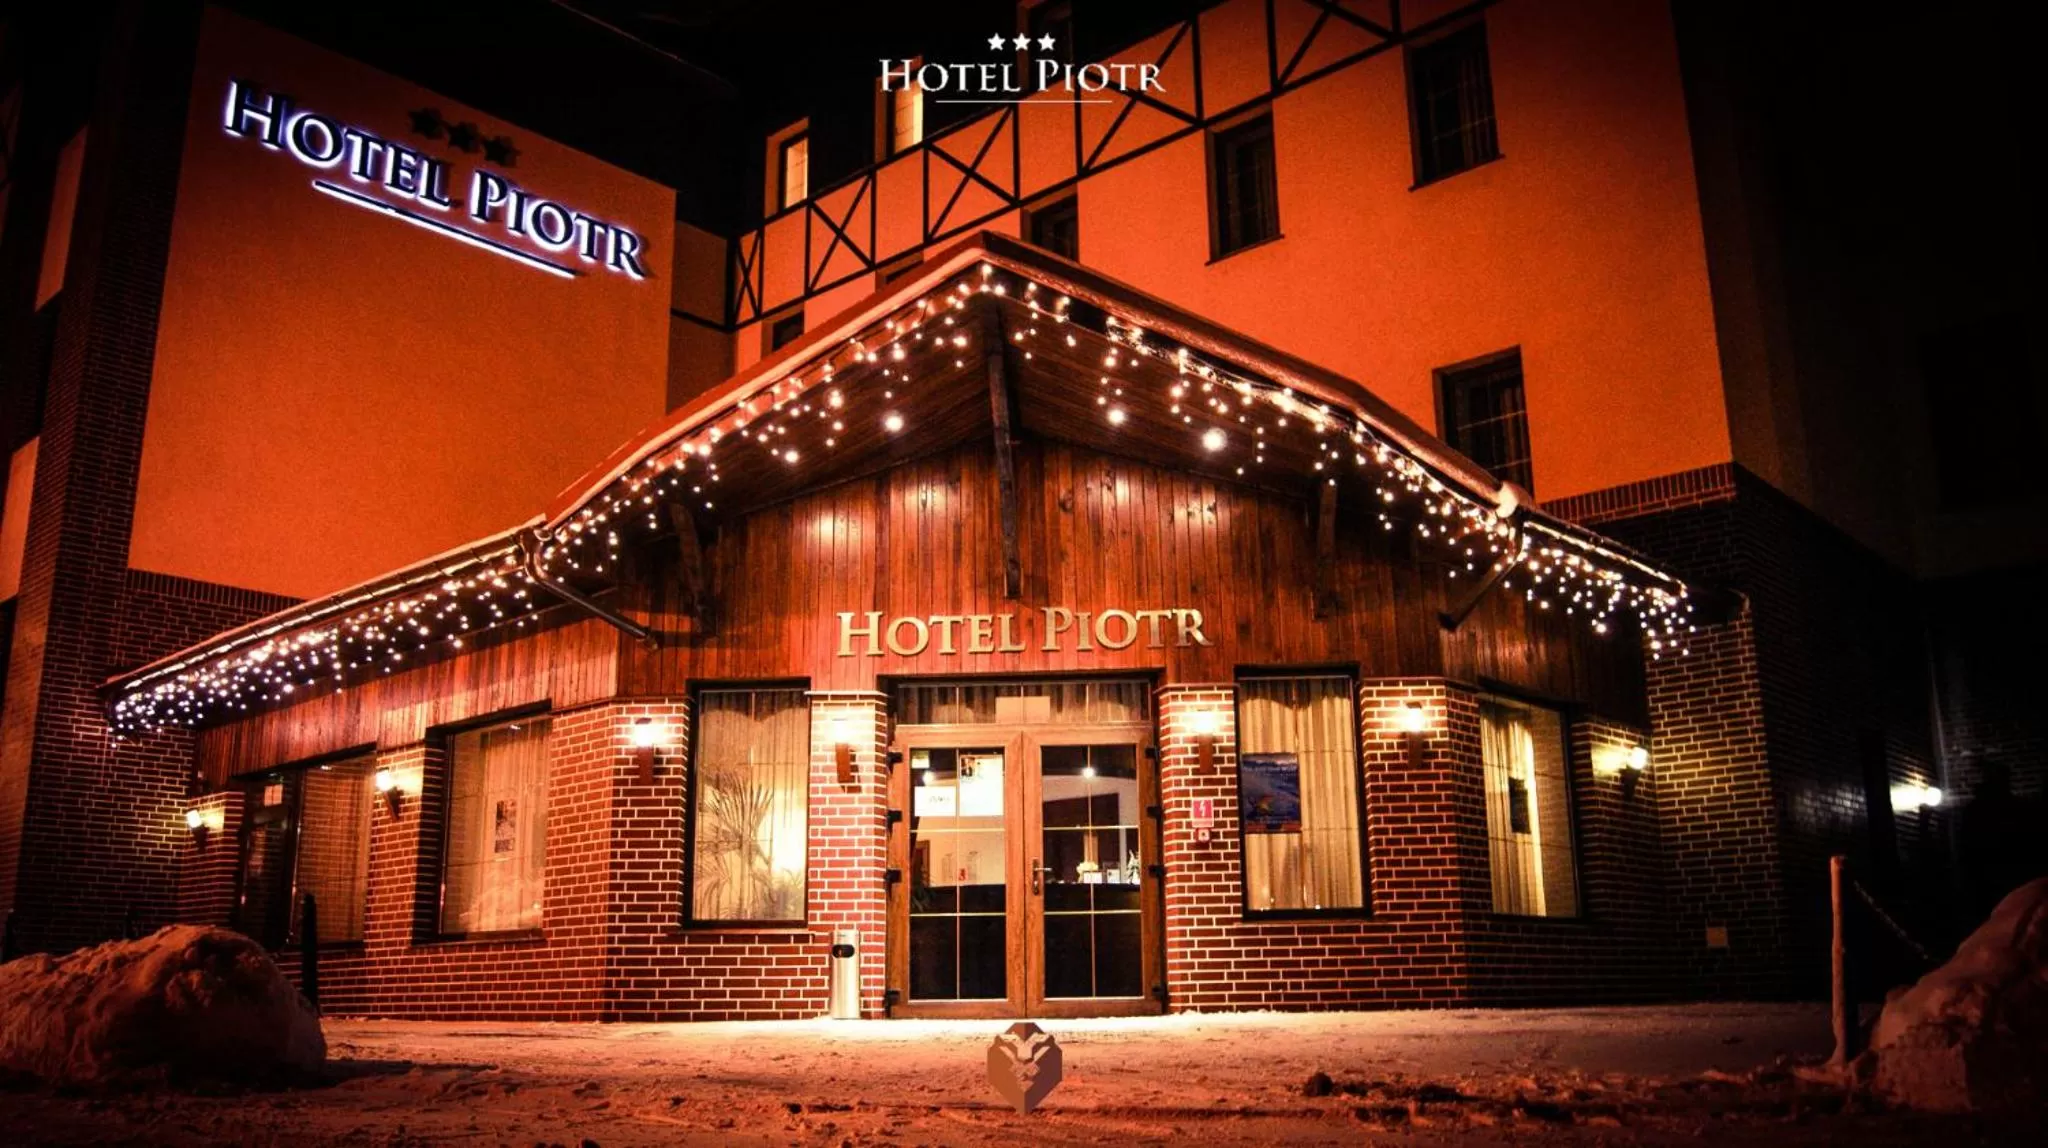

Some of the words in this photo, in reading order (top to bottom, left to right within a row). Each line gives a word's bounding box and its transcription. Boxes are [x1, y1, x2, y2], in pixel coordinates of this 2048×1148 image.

[224, 79, 451, 210] HOTEL
[471, 169, 646, 280] PIOTR
[836, 610, 1026, 657] HOTEL
[1040, 606, 1214, 651] PIOTR
